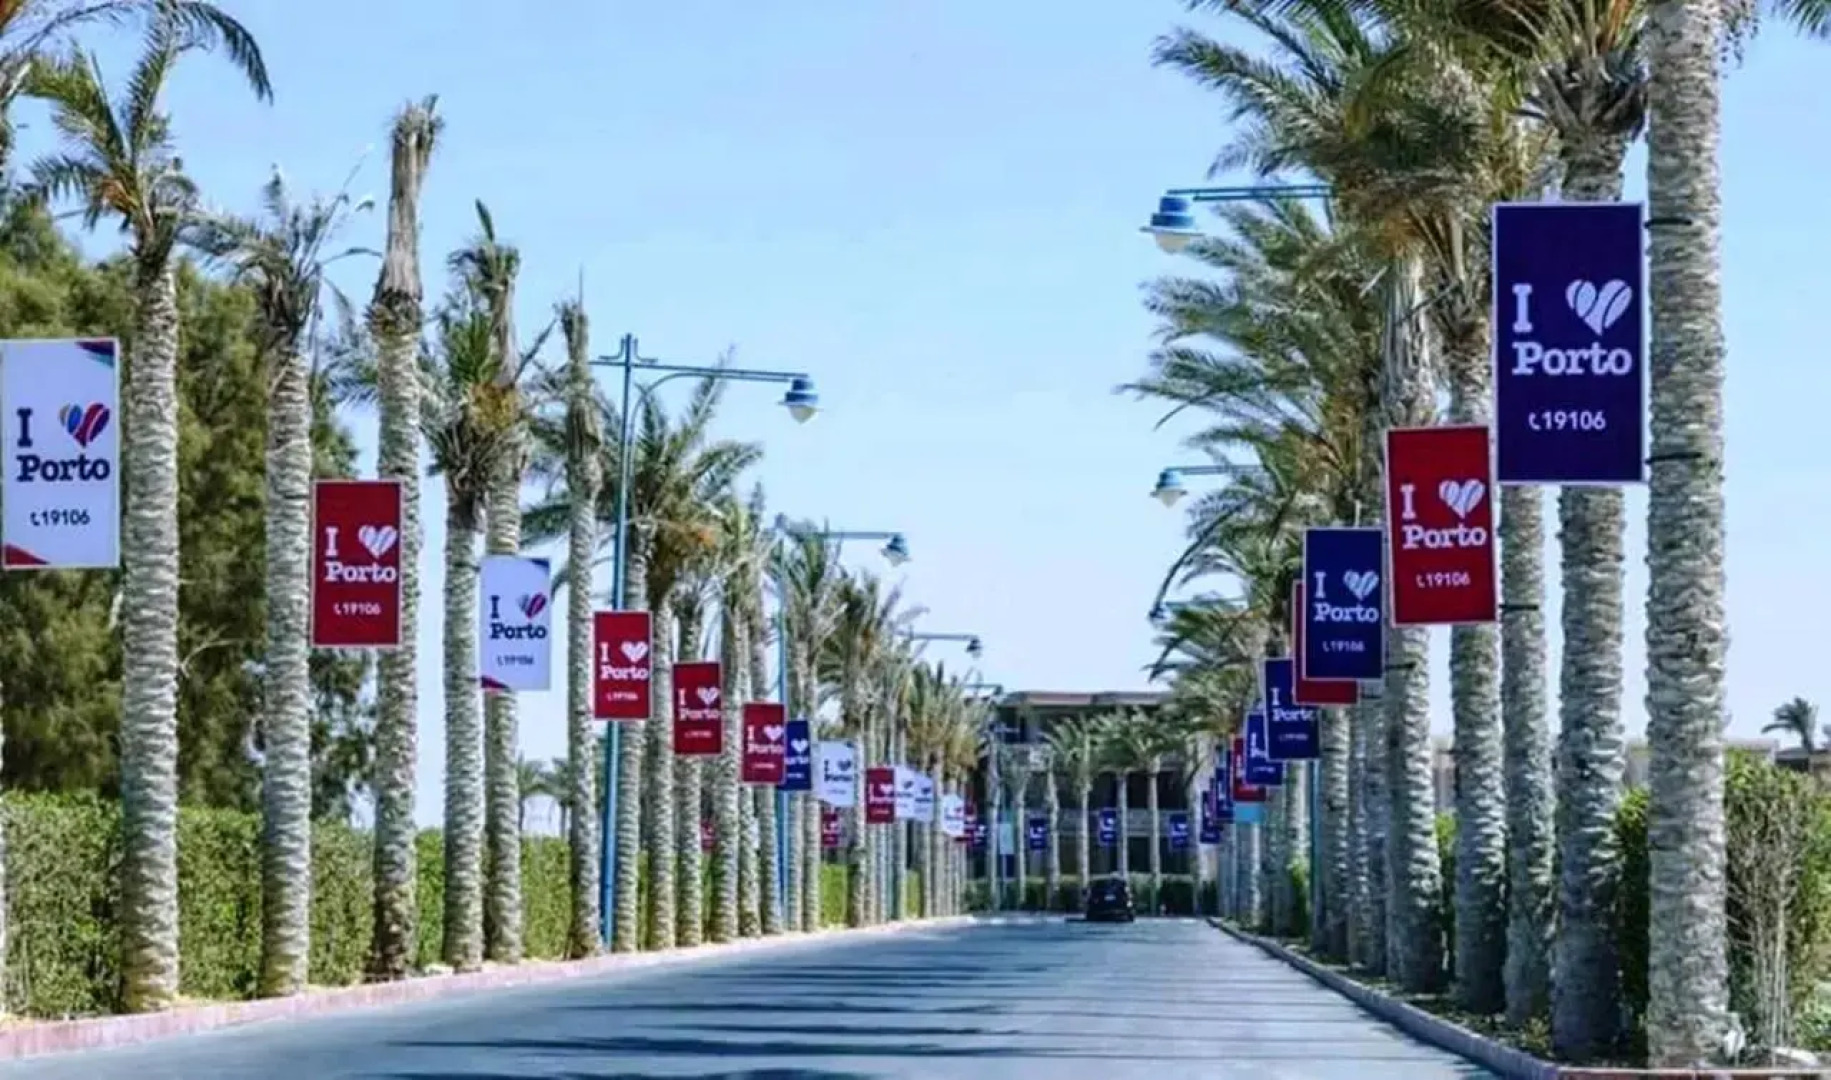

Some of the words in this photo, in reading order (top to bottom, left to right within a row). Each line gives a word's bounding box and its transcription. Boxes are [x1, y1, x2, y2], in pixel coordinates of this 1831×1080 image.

[1512, 283, 1533, 333] I
[1512, 341, 1633, 375] Porto
[16, 408, 32, 447] I
[1542, 411, 1606, 430] 19106
[16, 454, 111, 482] Porto
[1400, 483, 1416, 519] I
[42, 510, 90, 526] 19106
[325, 526, 339, 556] I
[1402, 524, 1487, 550] Porto
[324, 562, 397, 583] Porto
[1425, 572, 1470, 587] 19106
[1313, 571, 1326, 599] I
[343, 603, 382, 616] 19106
[490, 595, 500, 618] I
[1313, 602, 1379, 622] Porto
[489, 622, 547, 639] Porto
[600, 642, 609, 662] I
[600, 665, 649, 680] Porto
[678, 688, 686, 706] I
[1270, 687, 1280, 706] I
